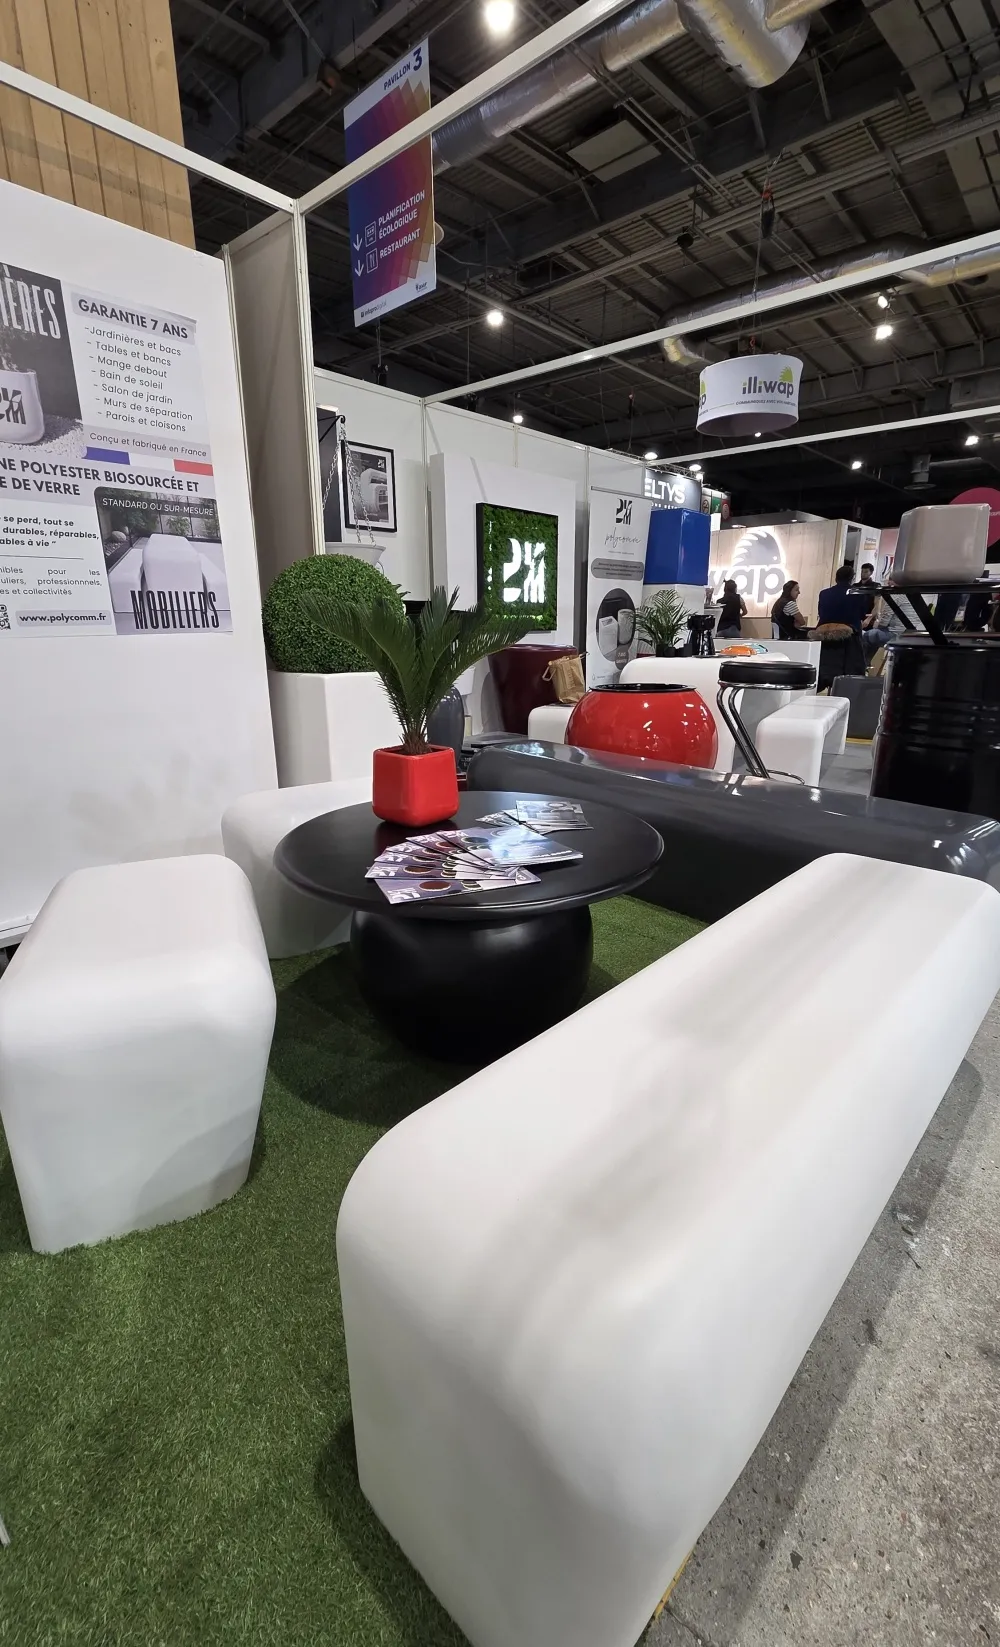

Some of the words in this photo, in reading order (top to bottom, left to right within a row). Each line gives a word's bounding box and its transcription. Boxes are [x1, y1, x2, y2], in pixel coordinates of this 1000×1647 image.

[383, 62, 411, 91] PAVILLON
[413, 46, 423, 72] 3
[378, 189, 425, 226] PLANIFICATION
[378, 208, 418, 239] ÉCOLOGIQUE
[379, 228, 421, 259] RESTAURANT
[78, 298, 148, 328] GARANTIE
[150, 318, 158, 331] 7
[162, 322, 188, 339] ANS
[95, 341, 128, 357] Tables
[130, 350, 140, 359] et
[143, 352, 172, 367] bancs
[147, 341, 157, 350] et
[159, 344, 182, 356] bacs
[97, 355, 131, 371] Mange
[134, 363, 167, 379] debout
[99, 369, 121, 382] Bain
[124, 374, 137, 384] de
[139, 377, 163, 390] soleil
[742, 376, 794, 398] illiwap
[101, 383, 129, 396] Salon
[132, 387, 144, 399] de
[146, 391, 173, 405] jardin
[103, 397, 127, 409] Murs
[130, 401, 142, 412] de
[145, 403, 193, 421] séparation
[106, 411, 135, 424] Parois
[138, 416, 147, 426] et
[150, 418, 186, 432] cloisons
[90, 432, 119, 446] Conçu
[121, 437, 130, 446] et
[132, 438, 167, 454] fabriqué
[181, 443, 207, 457] France
[12, 477, 31, 491] DE
[33, 480, 81, 496] VERRE
[20, 460, 101, 481] POLYESTER
[104, 470, 184, 491] BIOSOURCÉE
[187, 480, 200, 493] ET
[102, 497, 148, 510] STANDARD
[150, 501, 162, 511] OU
[164, 503, 214, 516] SUR-MESURE
[17, 516, 41, 525] perd,
[43, 518, 62, 526] tout
[3, 527, 47, 537] durables,
[49, 529, 99, 540] réparables,
[27, 539, 34, 547] à
[36, 539, 50, 547] vie
[23, 587, 72, 595] collectivités
[19, 613, 106, 624] www.polycomm.fr
[130, 590, 219, 629] MOBILIERS
